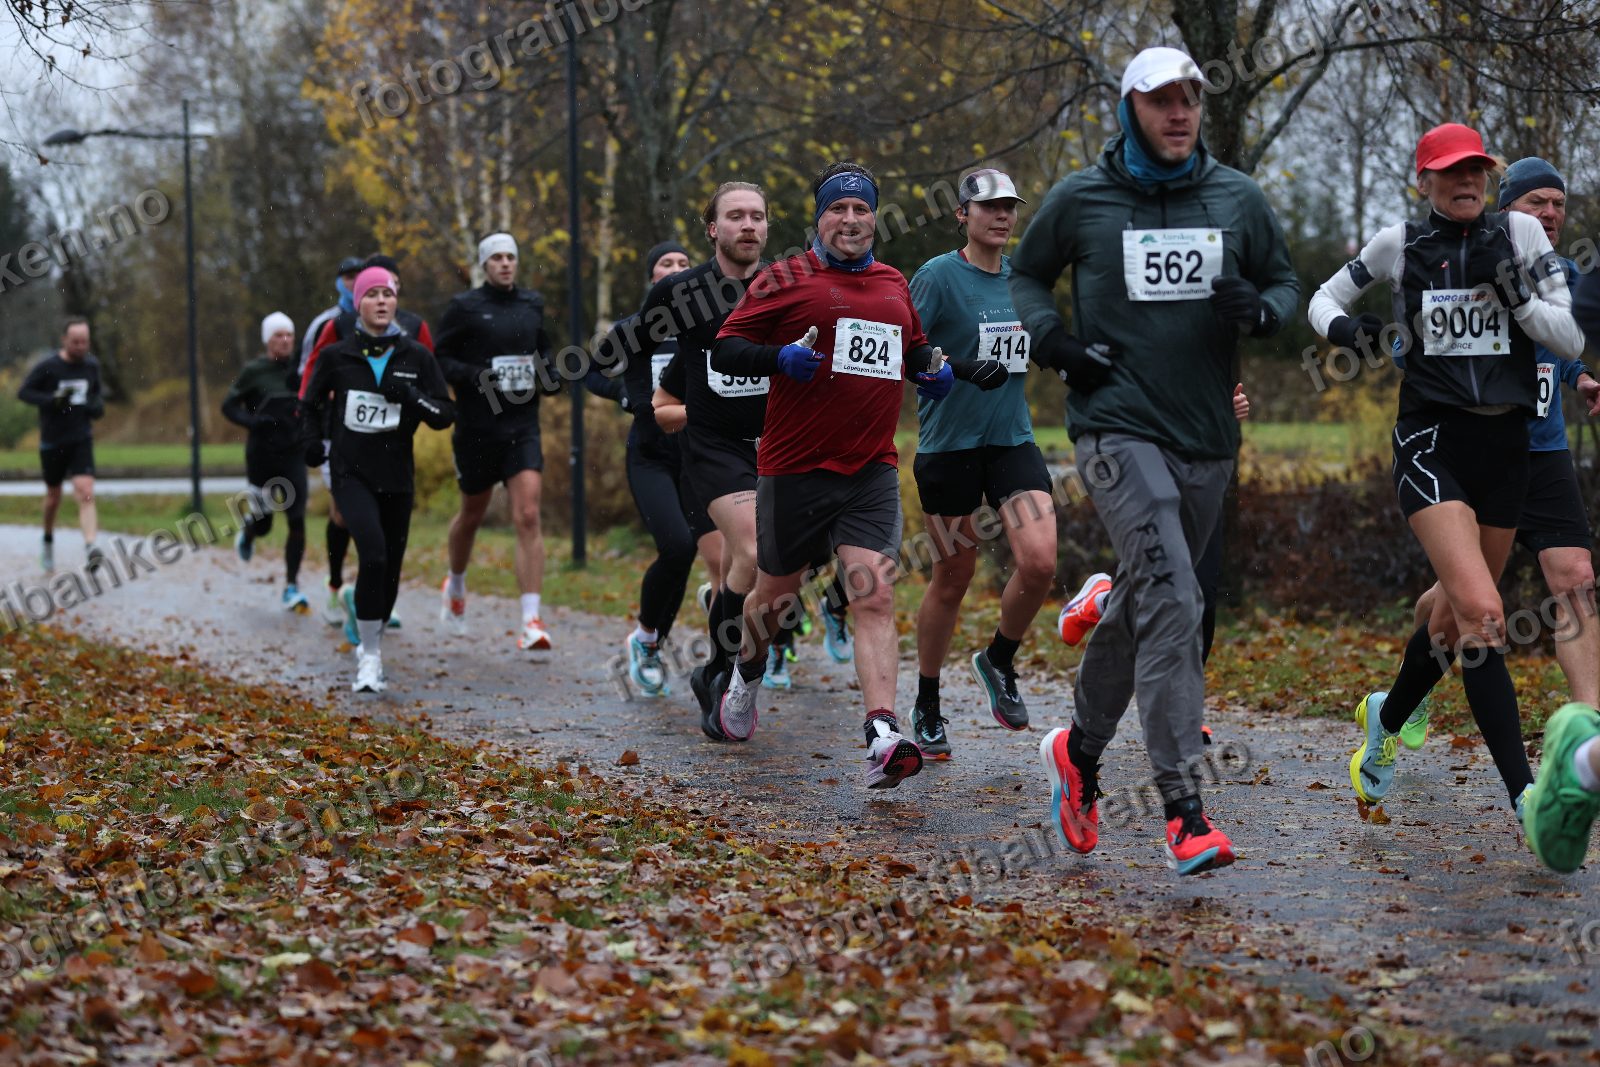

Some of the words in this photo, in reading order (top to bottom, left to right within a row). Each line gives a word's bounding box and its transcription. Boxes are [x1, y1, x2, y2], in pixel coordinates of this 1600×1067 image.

[1144, 250, 1203, 285] 562
[1430, 306, 1500, 339] 9004
[848, 335, 890, 367] 824
[990, 335, 1027, 361] 414
[356, 404, 388, 425] 671
